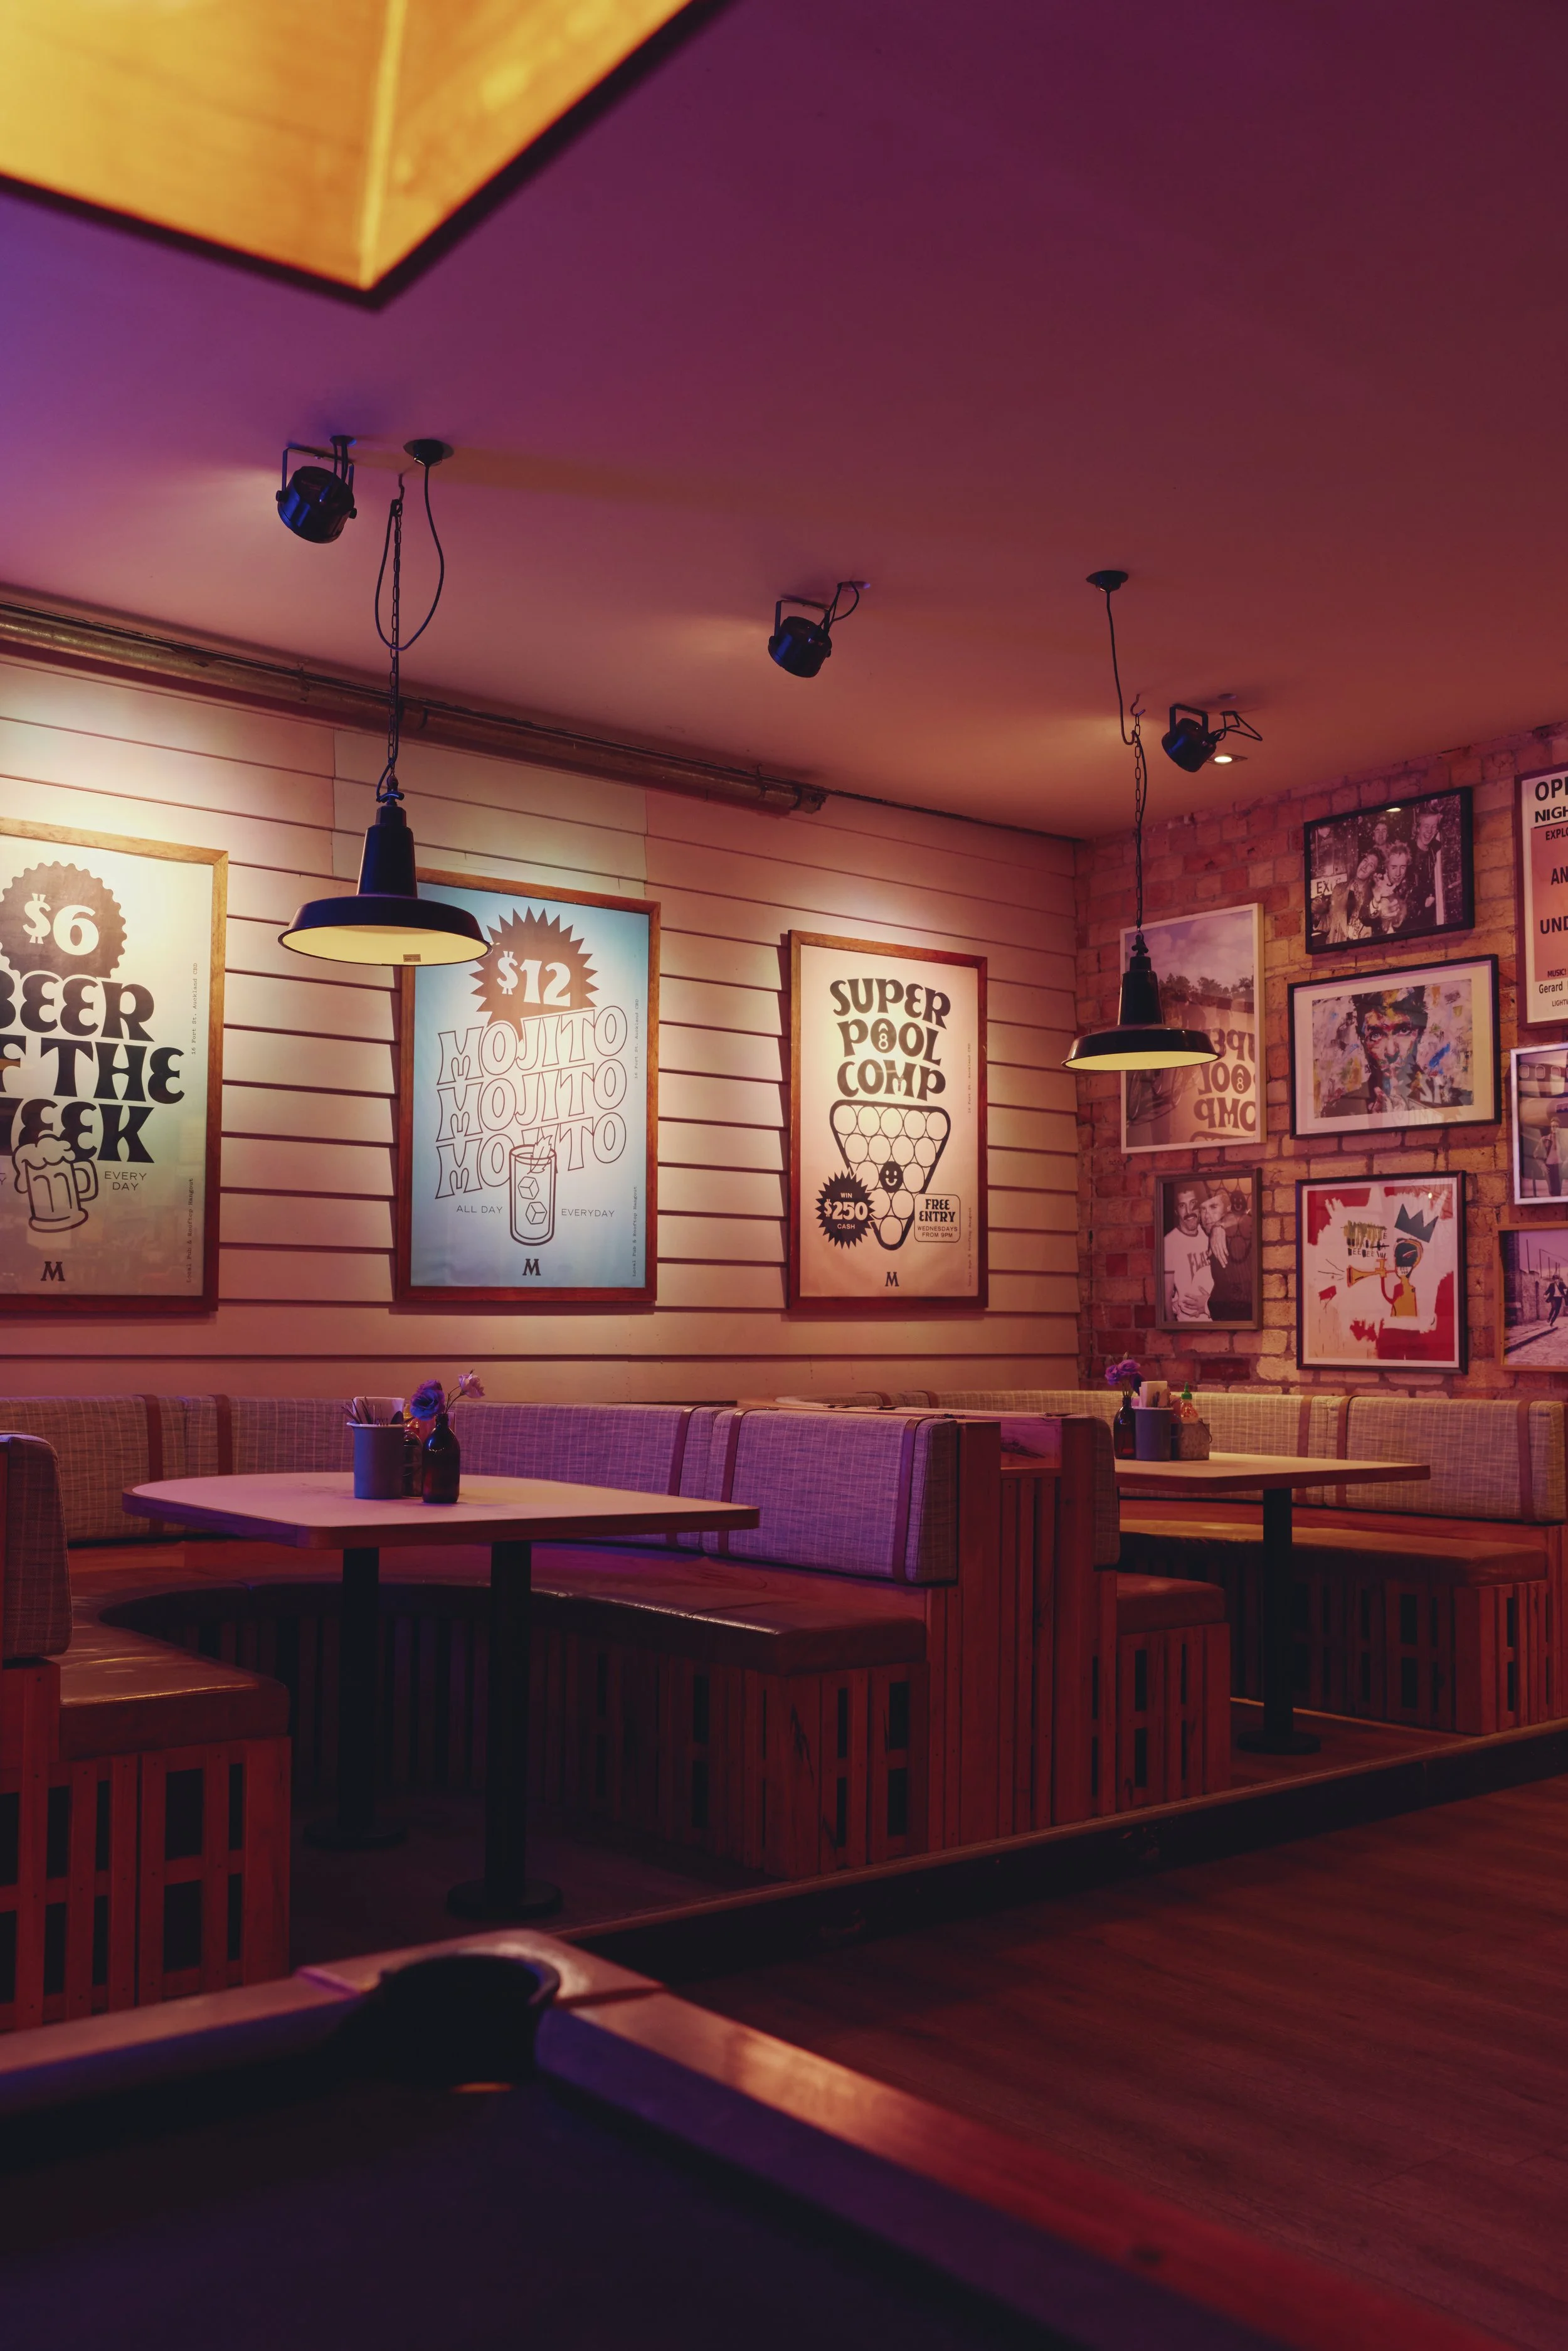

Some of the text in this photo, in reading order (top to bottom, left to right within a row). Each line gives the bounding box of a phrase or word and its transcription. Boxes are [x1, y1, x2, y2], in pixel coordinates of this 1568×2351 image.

[1535, 777, 1568, 801] OP
[23, 893, 99, 955] $6
[497, 950, 571, 1007] $12
[1547, 969, 1567, 977] MUSIC!
[1539, 980, 1563, 994] Gerard
[830, 978, 951, 1029] SUPER
[191, 1047, 196, 1055] 16
[437, 1006, 627, 1085] MOJITO
[837, 1018, 942, 1066] POOL
[40, 1037, 185, 1104] THE
[837, 1059, 946, 1101] COMP
[436, 1059, 627, 1142] MOJITO
[104, 1170, 147, 1181] EVERY
[112, 1182, 139, 1191] DAY
[456, 1204, 502, 1214] ALL DAY
[561, 1208, 615, 1218] EVERYDAY
[824, 1199, 868, 1221] $250
[925, 1199, 950, 1210] FREE
[919, 1211, 956, 1223] ENTRY
[40, 1261, 65, 1282] M
[522, 1258, 541, 1276] M
[885, 1271, 899, 1287] M
